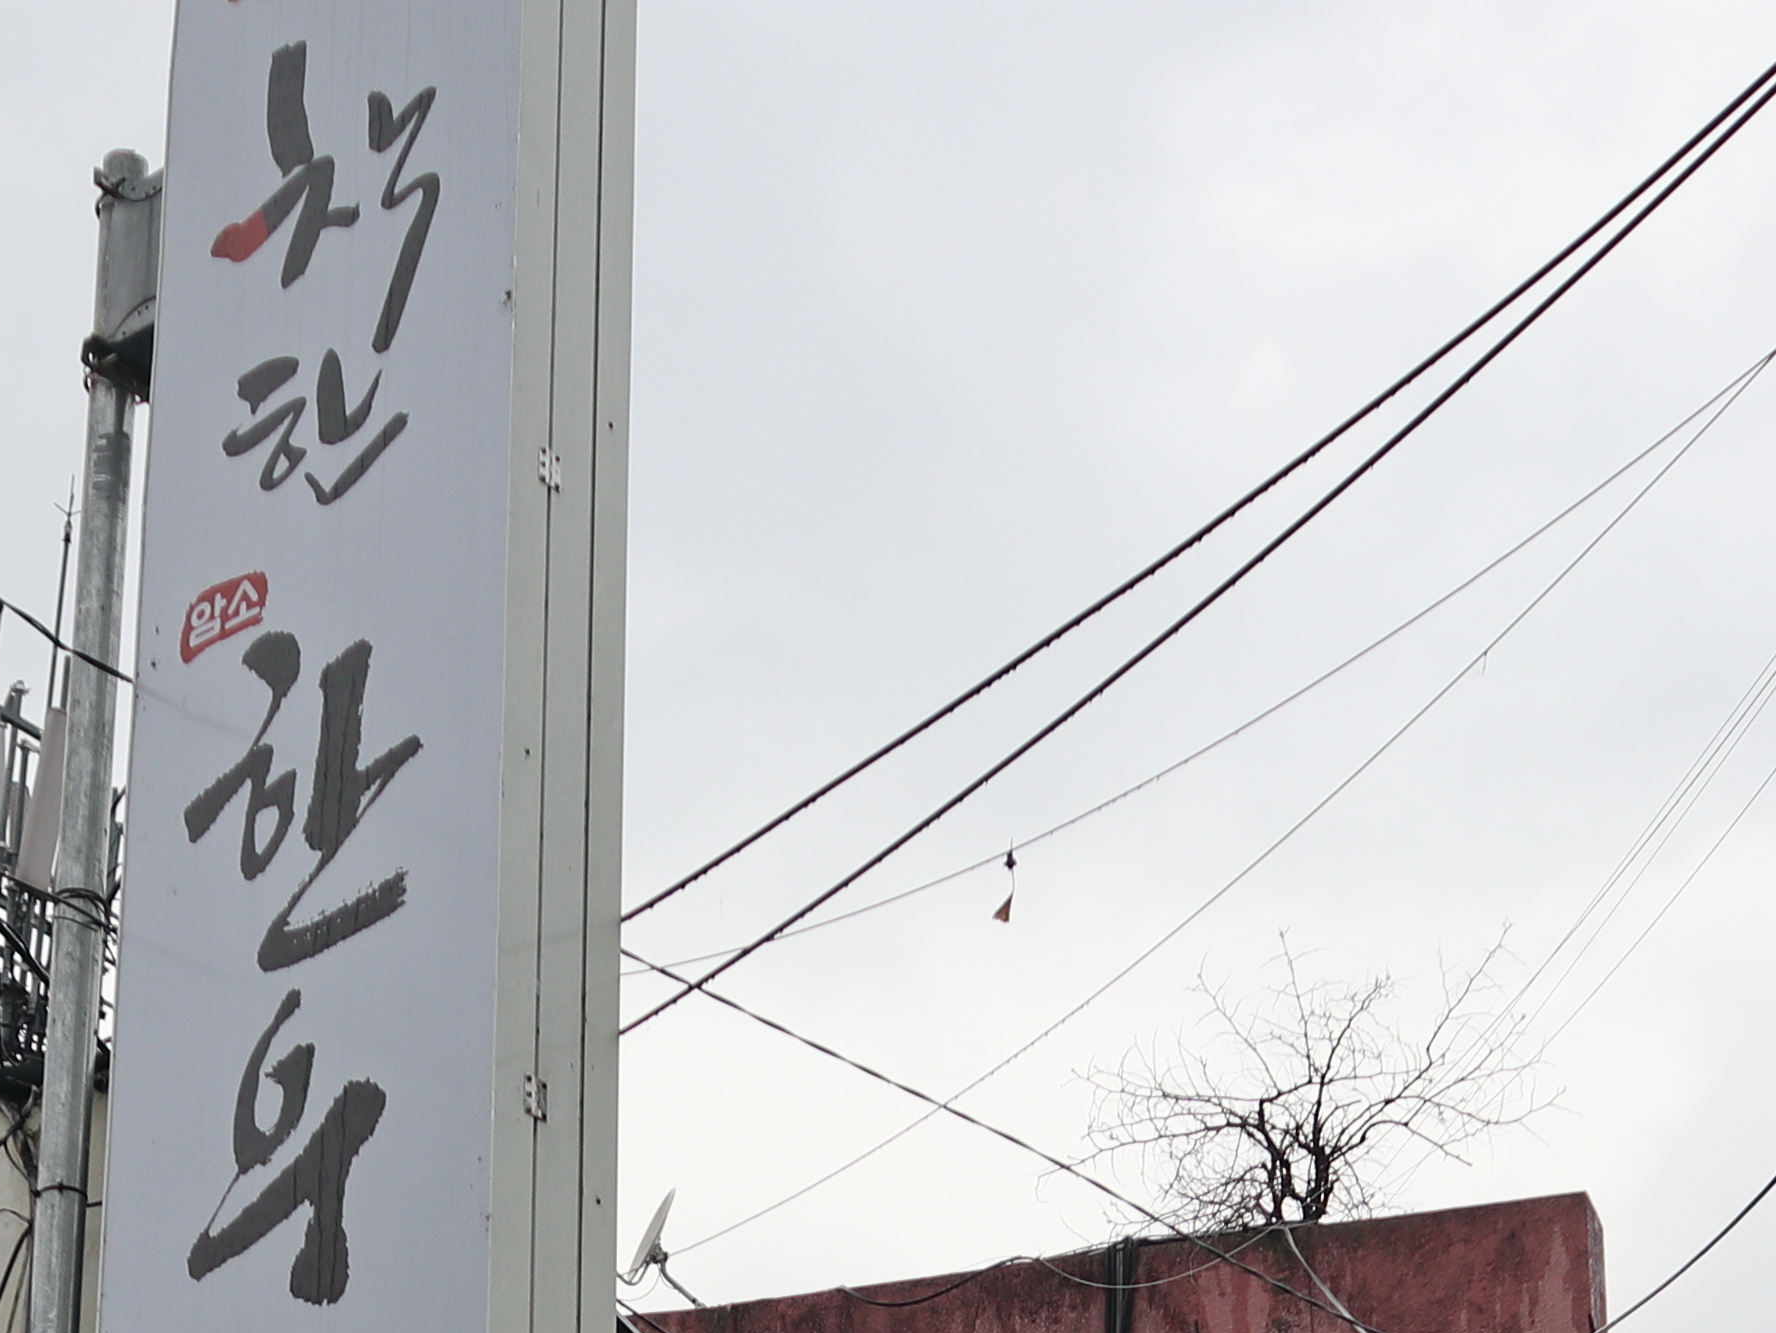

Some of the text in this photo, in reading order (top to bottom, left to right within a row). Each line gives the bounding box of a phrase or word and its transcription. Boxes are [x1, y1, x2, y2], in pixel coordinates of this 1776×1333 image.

[185, 41, 440, 1306] 착한 한우
[188, 580, 265, 650] 암소
